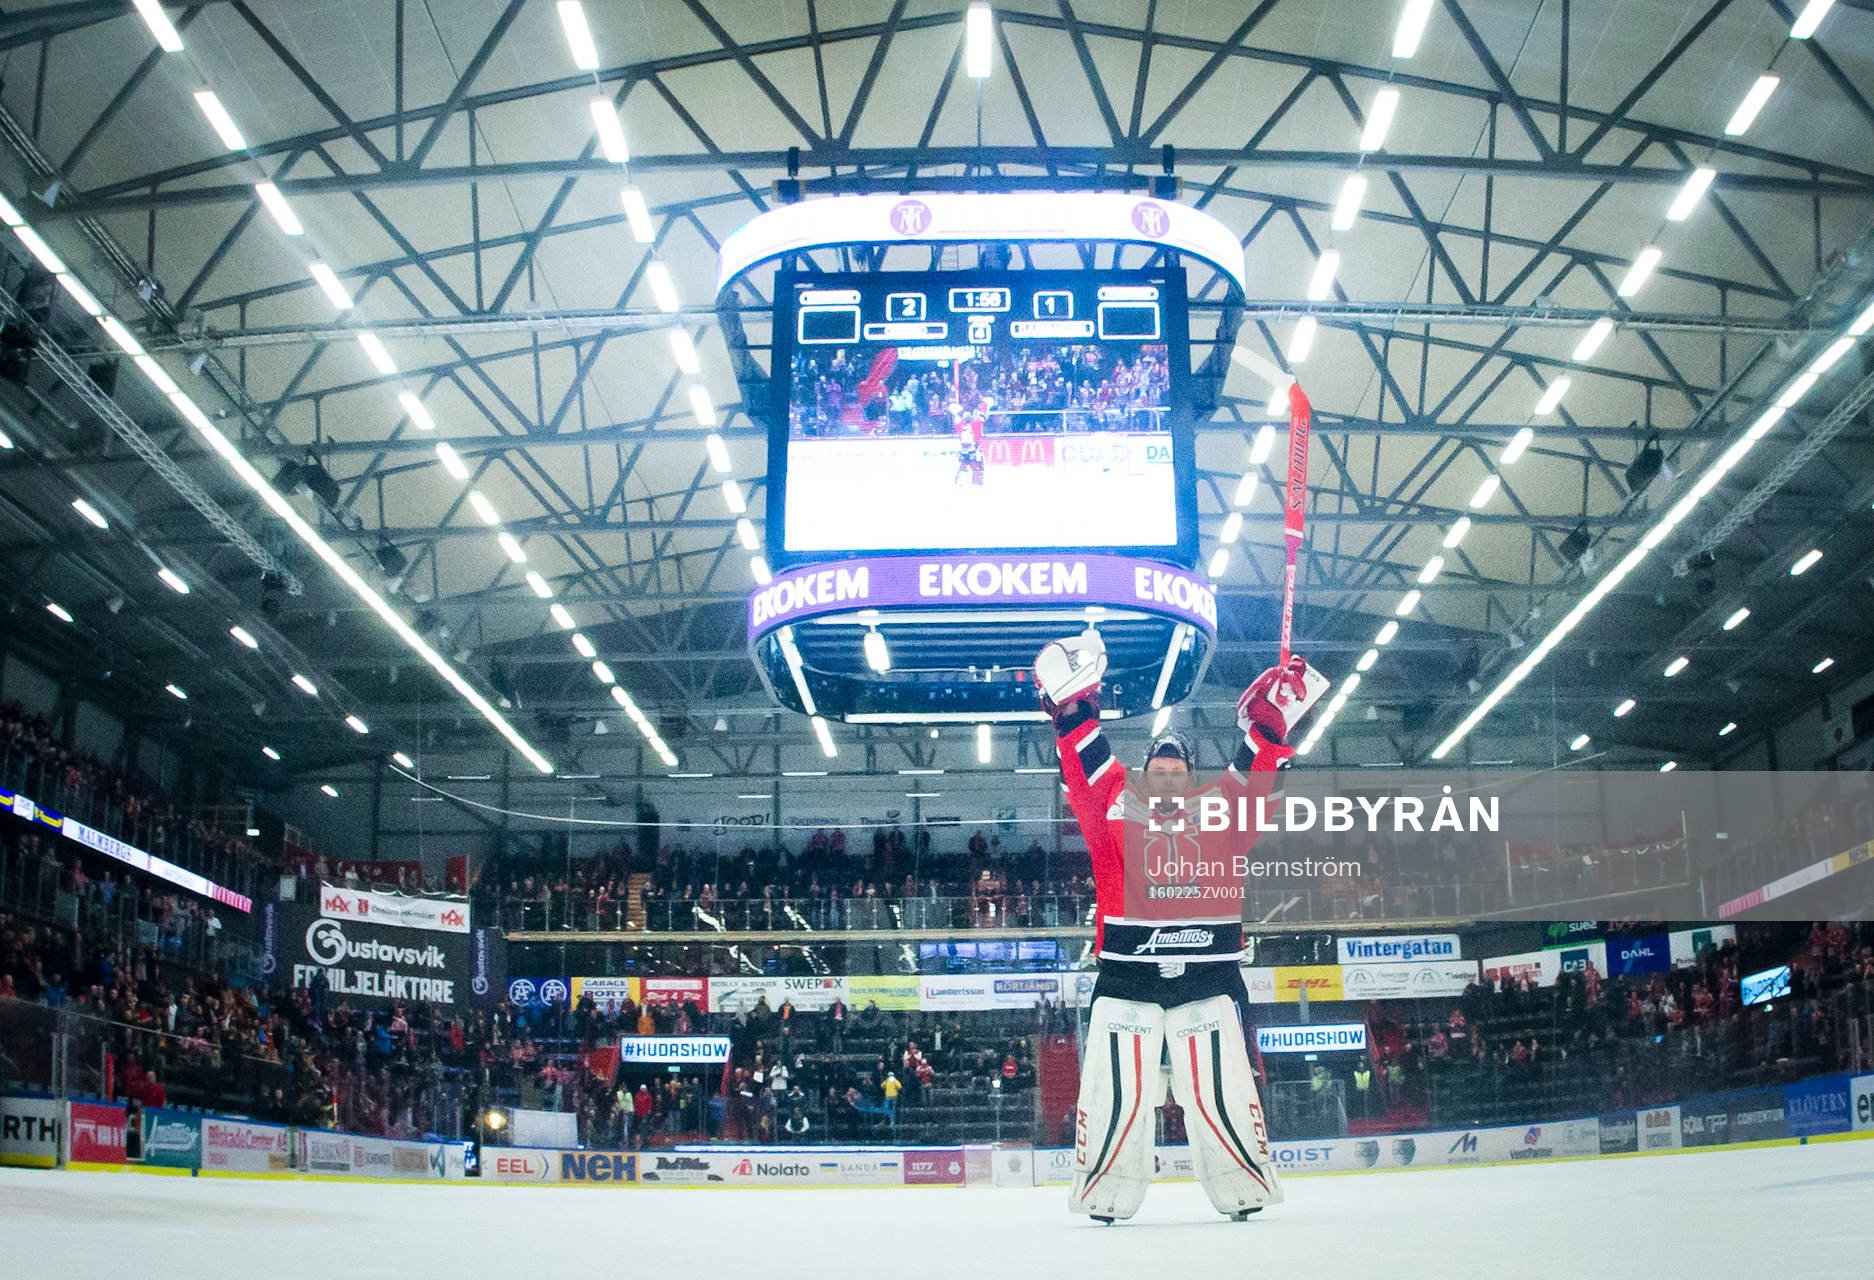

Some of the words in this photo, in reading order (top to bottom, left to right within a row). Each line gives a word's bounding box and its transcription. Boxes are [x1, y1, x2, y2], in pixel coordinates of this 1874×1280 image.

[902, 299, 916, 316] 2
[1045, 297, 1055, 314] 1
[919, 562, 1087, 596] EKOKEM
[753, 566, 869, 627] EKOKEM
[441, 908, 464, 927] MAX
[305, 918, 446, 969] Gustavsvik
[1347, 938, 1453, 959] Vintergatan
[1621, 947, 1656, 960] DAHL
[584, 979, 627, 988] GARAGE
[931, 987, 985, 996] Lambertsson
[1107, 1022, 1152, 1035] CONCENT
[1176, 1020, 1222, 1038] CONCENT
[1260, 1030, 1363, 1047] #HUDASHOW
[624, 1042, 728, 1057] #HUDASHOW
[1076, 1108, 1088, 1166] CCM
[1249, 1102, 1269, 1156] CCM
[496, 1157, 535, 1175] EEL
[757, 1162, 810, 1177] Nolato
